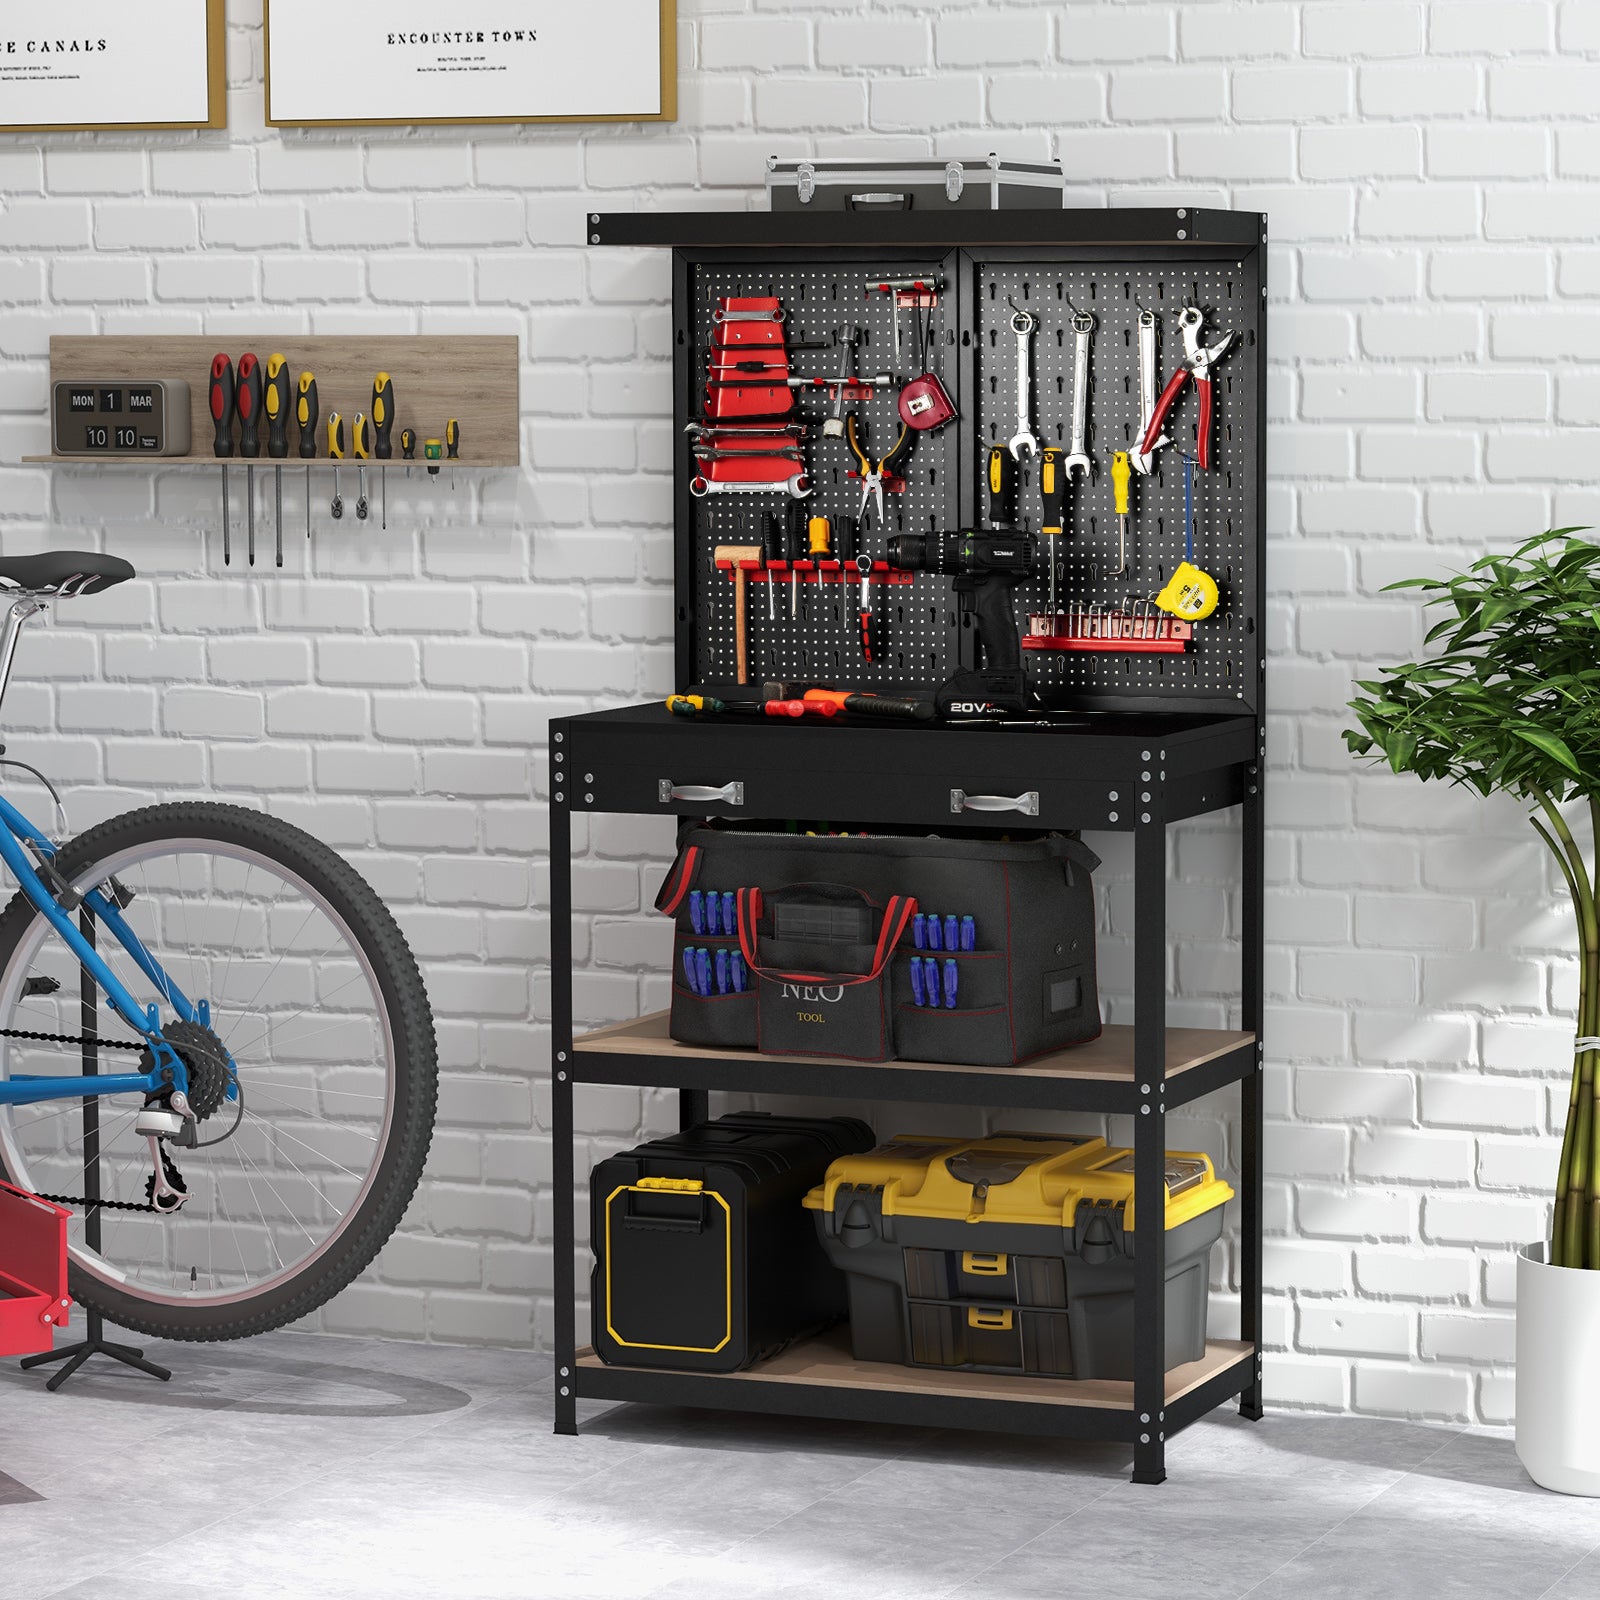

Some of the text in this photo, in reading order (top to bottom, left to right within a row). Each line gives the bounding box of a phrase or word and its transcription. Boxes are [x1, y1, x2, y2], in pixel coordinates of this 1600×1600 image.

[387, 29, 537, 45] ENCOUNTER TOWN
[26, 39, 107, 54] CANALS
[72, 392, 153, 410] MON 1 MAR
[88, 429, 107, 446] 10
[117, 429, 136, 446] 10
[950, 702, 987, 713] 20V
[781, 983, 844, 1003] NEO
[796, 1011, 826, 1023] TOOL
